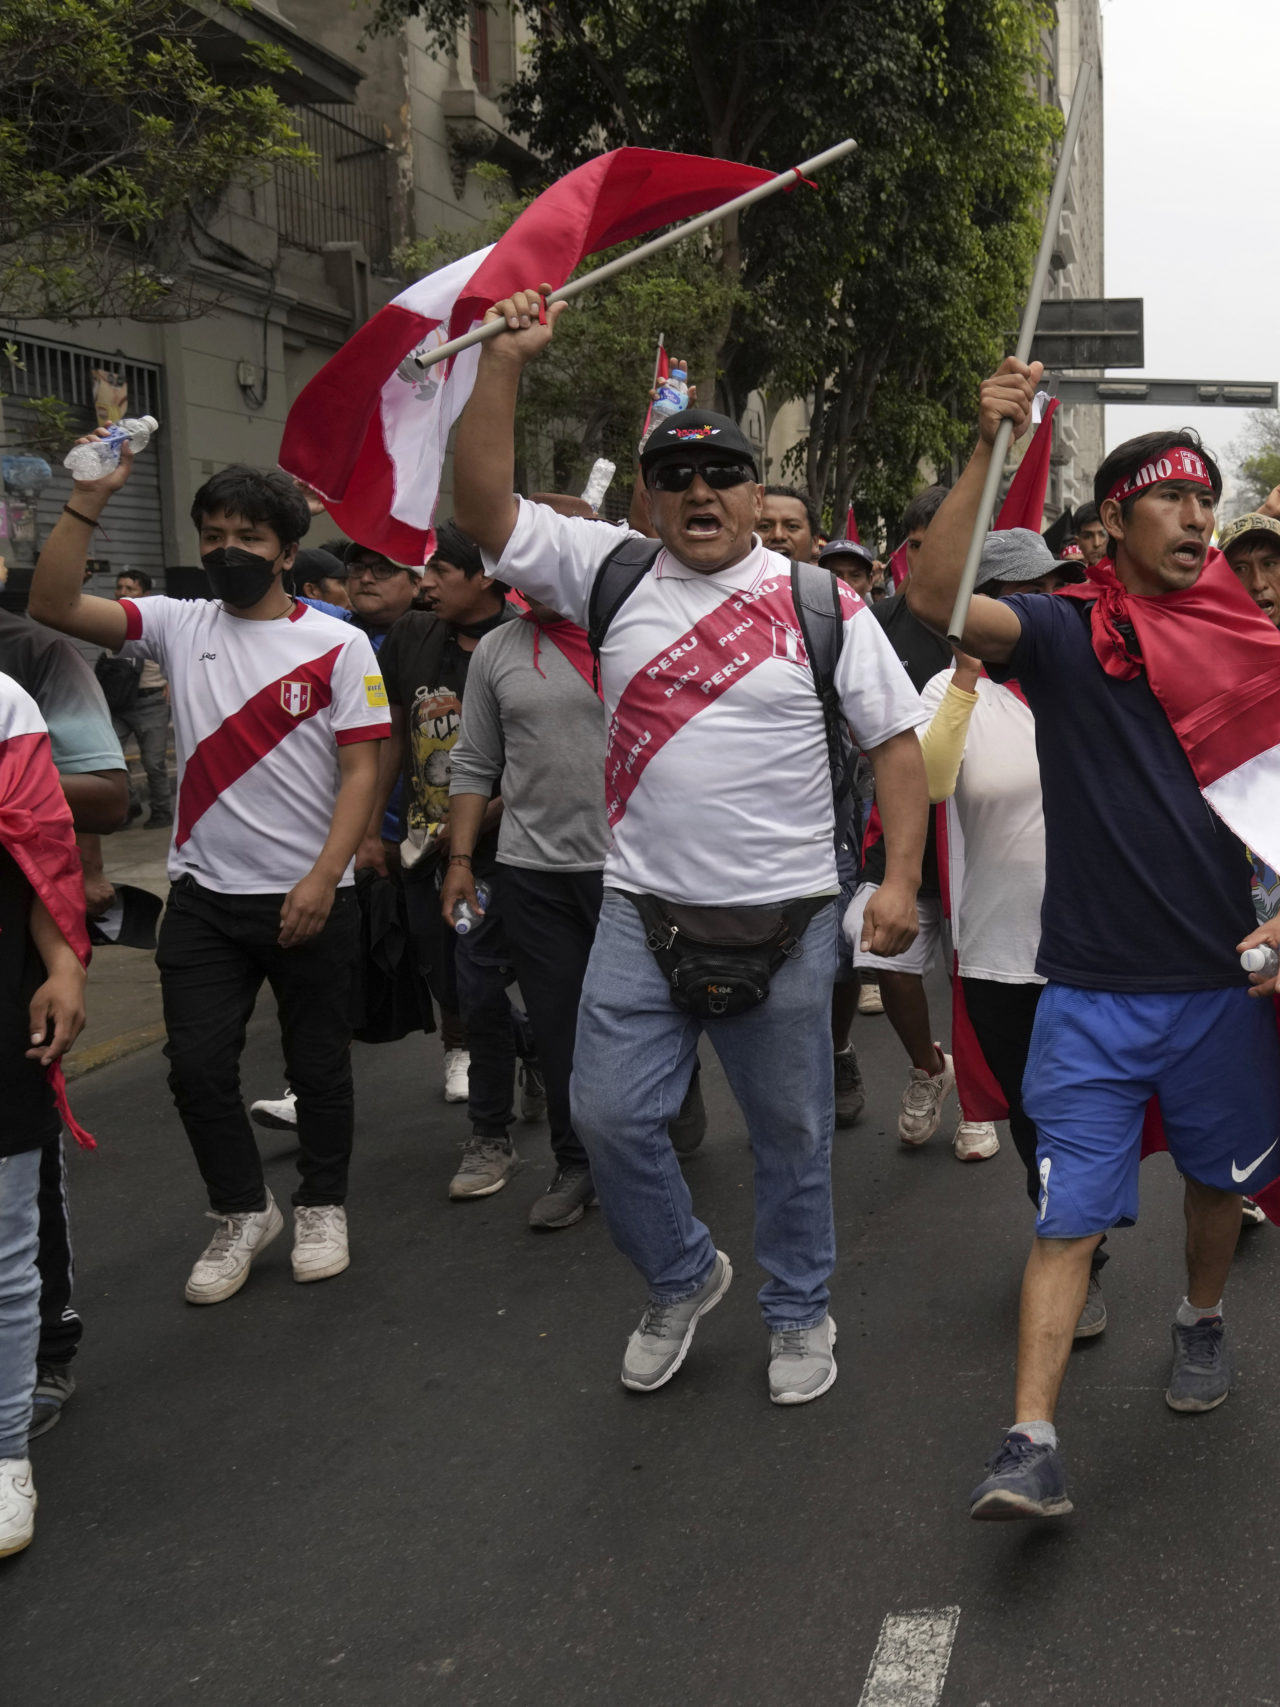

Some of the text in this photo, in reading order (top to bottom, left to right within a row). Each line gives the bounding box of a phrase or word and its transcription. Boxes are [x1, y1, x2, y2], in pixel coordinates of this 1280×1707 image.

[733, 582, 779, 611] PERU
[718, 617, 754, 647] PERU
[646, 636, 698, 680] PERU
[700, 652, 750, 694] PERU
[664, 665, 700, 698] PERU
[625, 730, 652, 774] PERU
